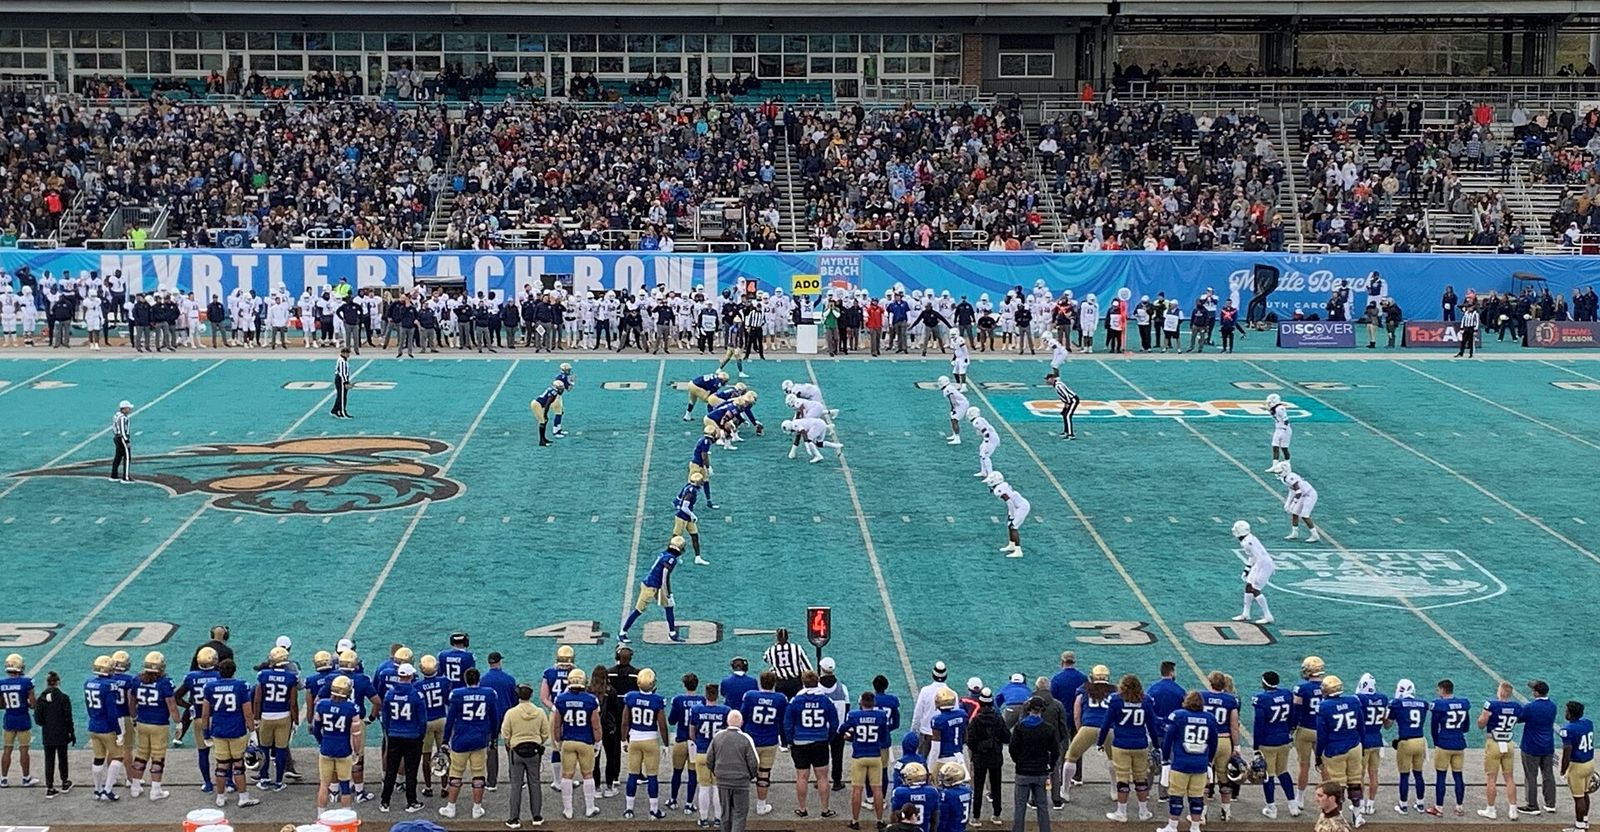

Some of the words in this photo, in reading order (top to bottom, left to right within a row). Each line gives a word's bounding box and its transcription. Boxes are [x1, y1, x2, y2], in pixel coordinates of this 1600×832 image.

[820, 257, 860, 266] MYRTLE
[1284, 256, 1323, 264] VISIT
[100, 254, 330, 306] MYRTLE
[356, 254, 546, 306] BEACH
[820, 266, 860, 276] BEACH
[794, 279, 820, 289] ADO
[1229, 269, 1306, 294] Mtle
[1281, 323, 1353, 334] DISCOVER
[811, 610, 826, 637] 4
[776, 650, 791, 667] H
[446, 663, 461, 682] 12
[3, 692, 20, 709] 18
[136, 688, 159, 706] 52
[265, 683, 288, 702] 32
[425, 688, 443, 708] 15
[212, 693, 237, 712] 79
[389, 702, 412, 720] 34
[462, 702, 487, 721] 54
[322, 713, 346, 732] 54
[563, 709, 587, 727] 48
[631, 707, 654, 726] 80
[752, 706, 777, 725] 62
[801, 709, 825, 728] 65
[1119, 708, 1145, 726] 70
[1269, 703, 1290, 723] 72
[1332, 711, 1357, 732] 76
[1365, 706, 1384, 725] 32
[1409, 709, 1421, 728] 9
[1445, 710, 1467, 729] 27
[1497, 715, 1518, 732] 39
[855, 725, 879, 743] 95
[953, 726, 960, 746] 1
[1184, 724, 1209, 744] 60
